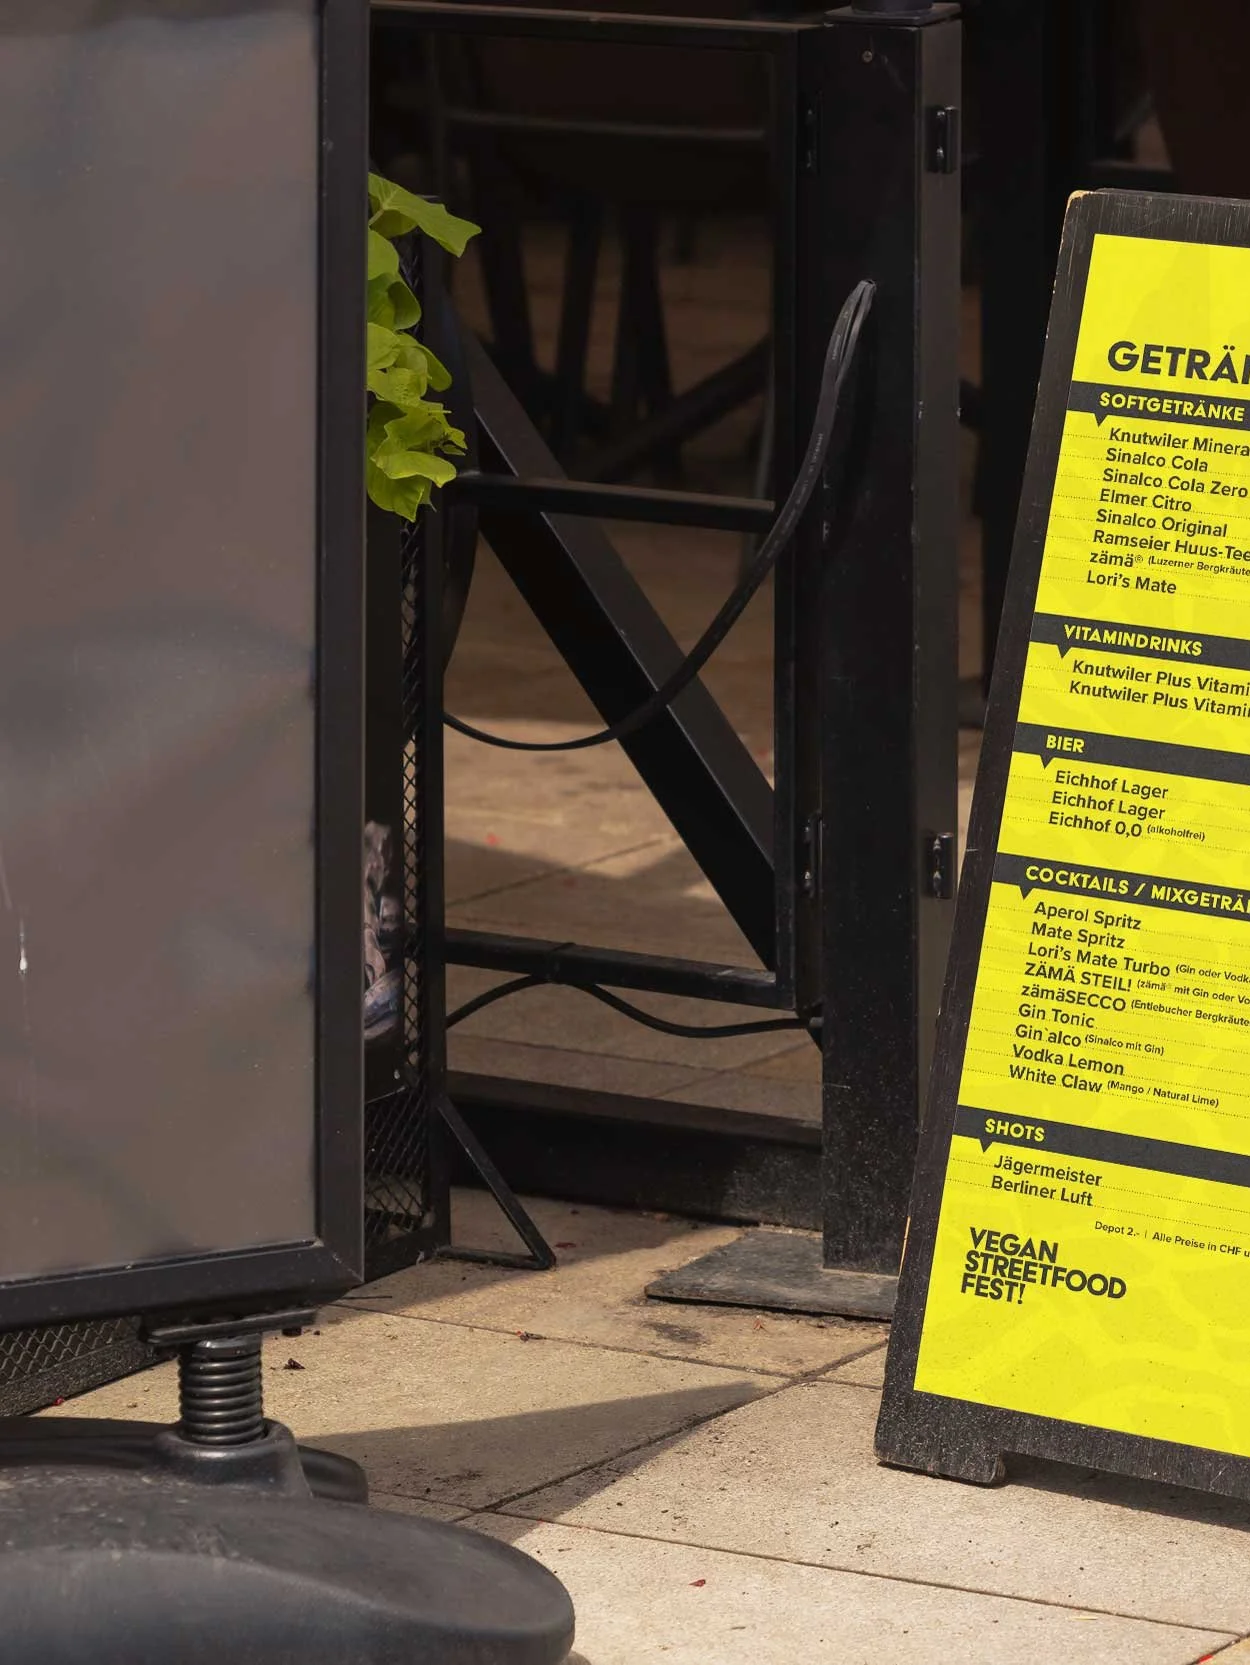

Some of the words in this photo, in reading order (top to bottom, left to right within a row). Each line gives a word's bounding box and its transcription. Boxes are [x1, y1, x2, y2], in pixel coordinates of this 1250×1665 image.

[1099, 391, 1245, 422] SOFTGETRÄNKE
[1109, 427, 1189, 449] Knutwiler
[1105, 447, 1166, 468] Sinalco
[1171, 455, 1208, 473] Cola
[1102, 467, 1163, 488] Sinalco
[1168, 475, 1205, 493] Cola
[1209, 480, 1249, 498] Zero
[1099, 488, 1148, 507] Elmer
[1152, 494, 1192, 512] Citro
[1095, 508, 1157, 529] Sinalco
[1161, 516, 1228, 538] Original
[1092, 529, 1171, 552] Ramseier
[1147, 555, 1195, 569] (Luzerner
[1135, 576, 1177, 594] Mate
[1064, 624, 1203, 657] VITAMINDRINKS
[1072, 659, 1152, 683] Knutwiler
[1155, 671, 1192, 689] Plus
[1069, 680, 1149, 704] Knutwiler
[1152, 691, 1188, 710] Plus
[1046, 734, 1085, 753] BIER
[1055, 770, 1119, 792] Eichhof
[1121, 779, 1169, 800] Lager
[1051, 790, 1115, 812] Eichhof
[1118, 800, 1166, 821] Lager
[1048, 811, 1112, 833] Eichhof
[1114, 821, 1143, 838] 0,0
[1146, 824, 1206, 842] (alkoholfrei)
[1025, 865, 1129, 895] COCKTAILS
[1033, 901, 1089, 922] Aperol
[1093, 910, 1142, 930] Spritz
[1031, 921, 1073, 941] Mate
[1077, 928, 1126, 949] Spritz
[1076, 949, 1118, 969] Mate
[1123, 956, 1171, 977] Turbo
[1175, 963, 1196, 975] (Gin
[1198, 968, 1222, 979] oder
[1024, 960, 1076, 983] ZÄMÄ
[1080, 971, 1132, 992] STEIL!
[1173, 985, 1191, 996] mit
[1191, 987, 1209, 998] Gin
[1211, 992, 1235, 1003] oder
[1021, 983, 1127, 1012] zämäSECCO
[1130, 999, 1193, 1017] (Entlebucher
[1018, 1003, 1046, 1021] Gin
[1051, 1008, 1095, 1029] Tonic
[1012, 1043, 1064, 1066] Vodka
[1068, 1053, 1124, 1076] Lemon
[1084, 1033, 1124, 1048] (Sinalco
[1125, 1041, 1142, 1052] mit
[1144, 1043, 1165, 1057] Gin)
[1009, 1064, 1057, 1086] White
[1061, 1073, 1103, 1093] Claw
[1107, 1080, 1145, 1095] (Mango
[1152, 1087, 1190, 1102] Natural
[1191, 1094, 1219, 1109] Lime)
[985, 1118, 1045, 1142] SHOTS
[993, 1155, 1103, 1187] Jägermeister
[990, 1175, 1057, 1200] Berliner
[1060, 1187, 1093, 1207] Luft
[969, 1226, 1059, 1264] VEGAN
[1094, 1220, 1125, 1235] Depot
[1151, 1231, 1172, 1243] Alle
[1174, 1235, 1206, 1249] Preise
[1207, 1241, 1217, 1252] in
[1219, 1244, 1242, 1256] CHF
[960, 1272, 1026, 1305] FEST!
[964, 1249, 1127, 1299] STREETFOOD
